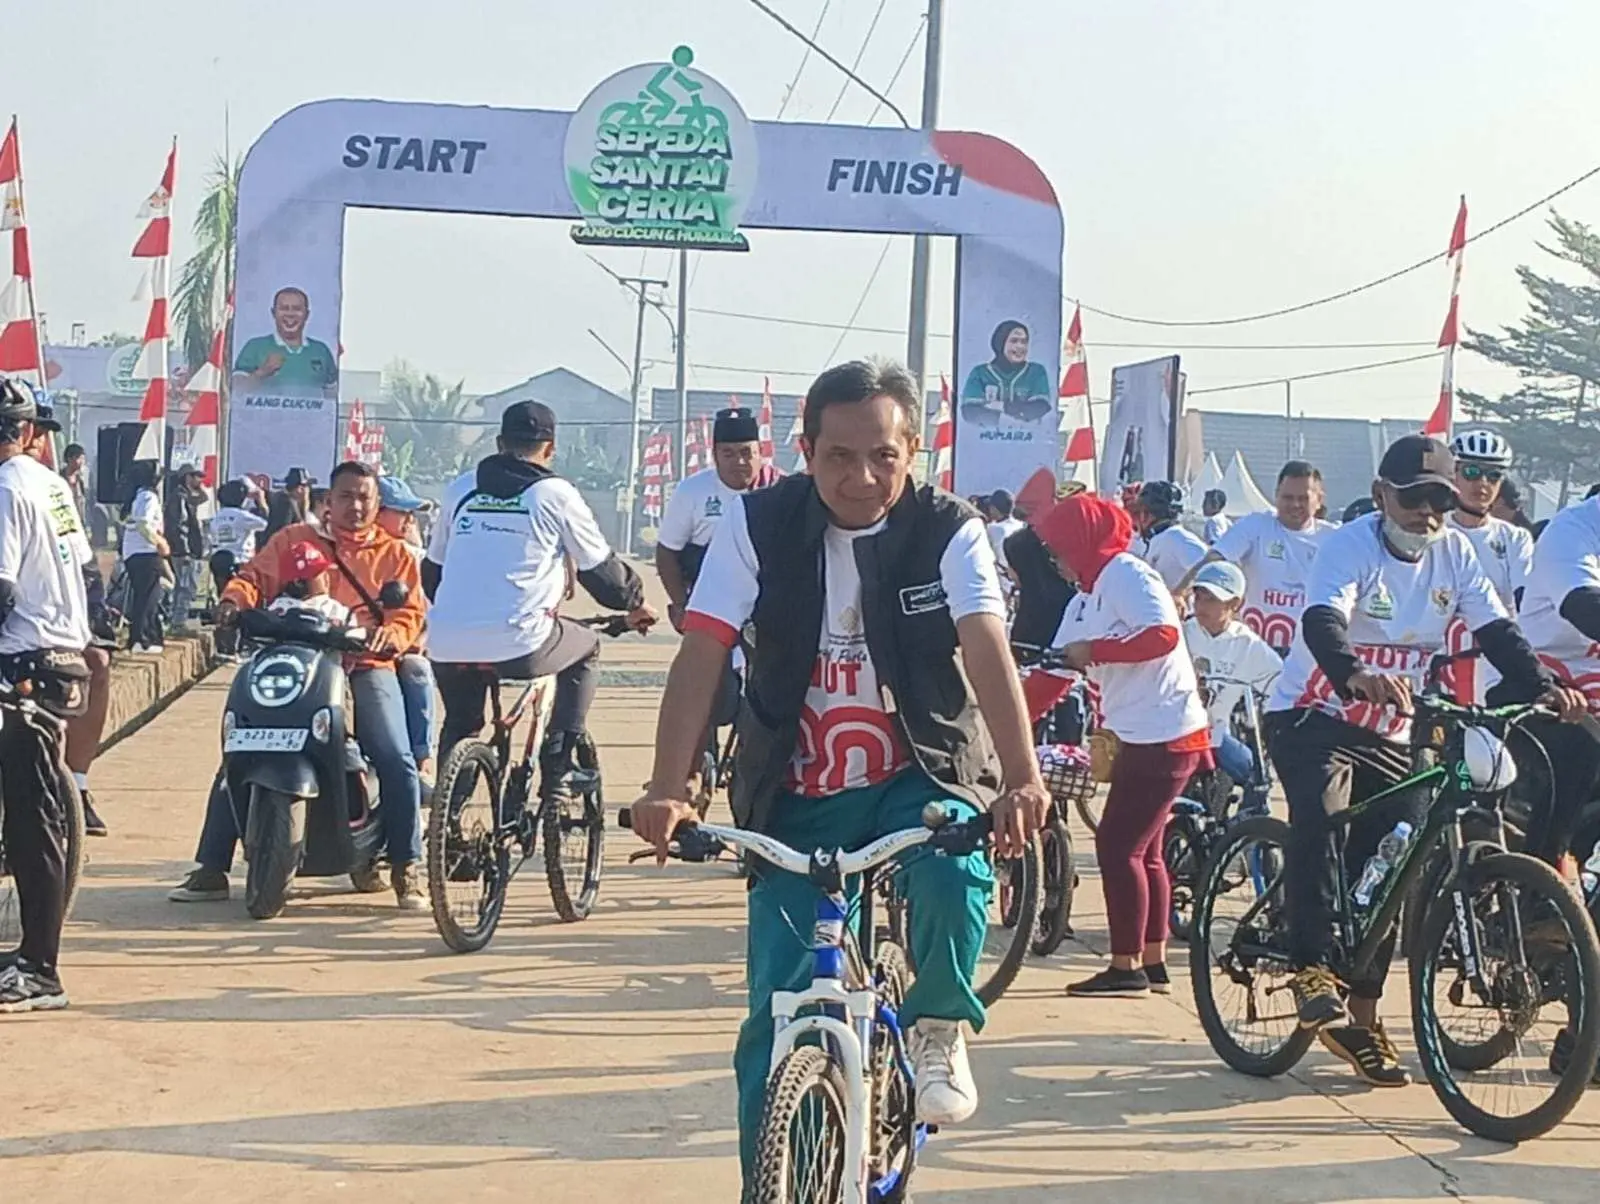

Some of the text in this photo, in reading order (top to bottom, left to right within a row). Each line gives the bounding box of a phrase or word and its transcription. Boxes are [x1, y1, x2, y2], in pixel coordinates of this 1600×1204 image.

[343, 135, 487, 174] START
[596, 125, 732, 158] SEPEDA
[590, 156, 727, 189] SANTAI
[827, 159, 963, 196] FINISH
[599, 189, 718, 224] CERIA
[572, 225, 612, 240] KANG
[613, 226, 663, 241] CUCUN
[245, 396, 324, 409] KANG CUCUN
[1264, 589, 1298, 607] HUT
[1353, 645, 1411, 671] HUT
